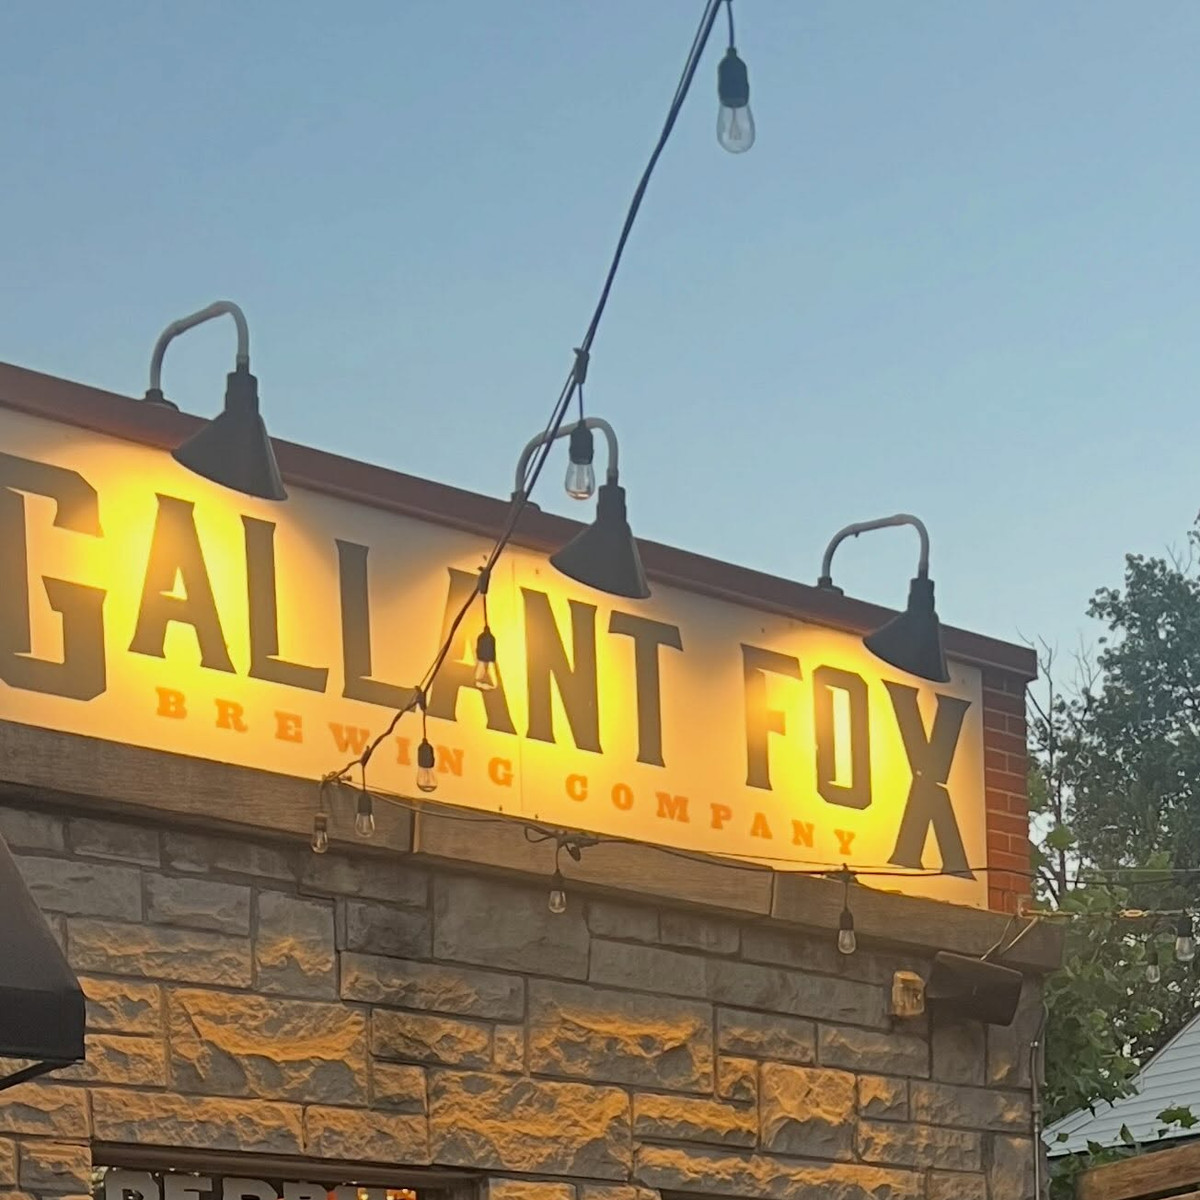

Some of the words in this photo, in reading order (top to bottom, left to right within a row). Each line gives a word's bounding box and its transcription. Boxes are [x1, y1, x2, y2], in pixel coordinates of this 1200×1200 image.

[0, 452, 684, 768] GALLANT
[740, 643, 977, 880] FOX
[155, 686, 515, 787] BREWING
[565, 773, 857, 855] COMPANY
